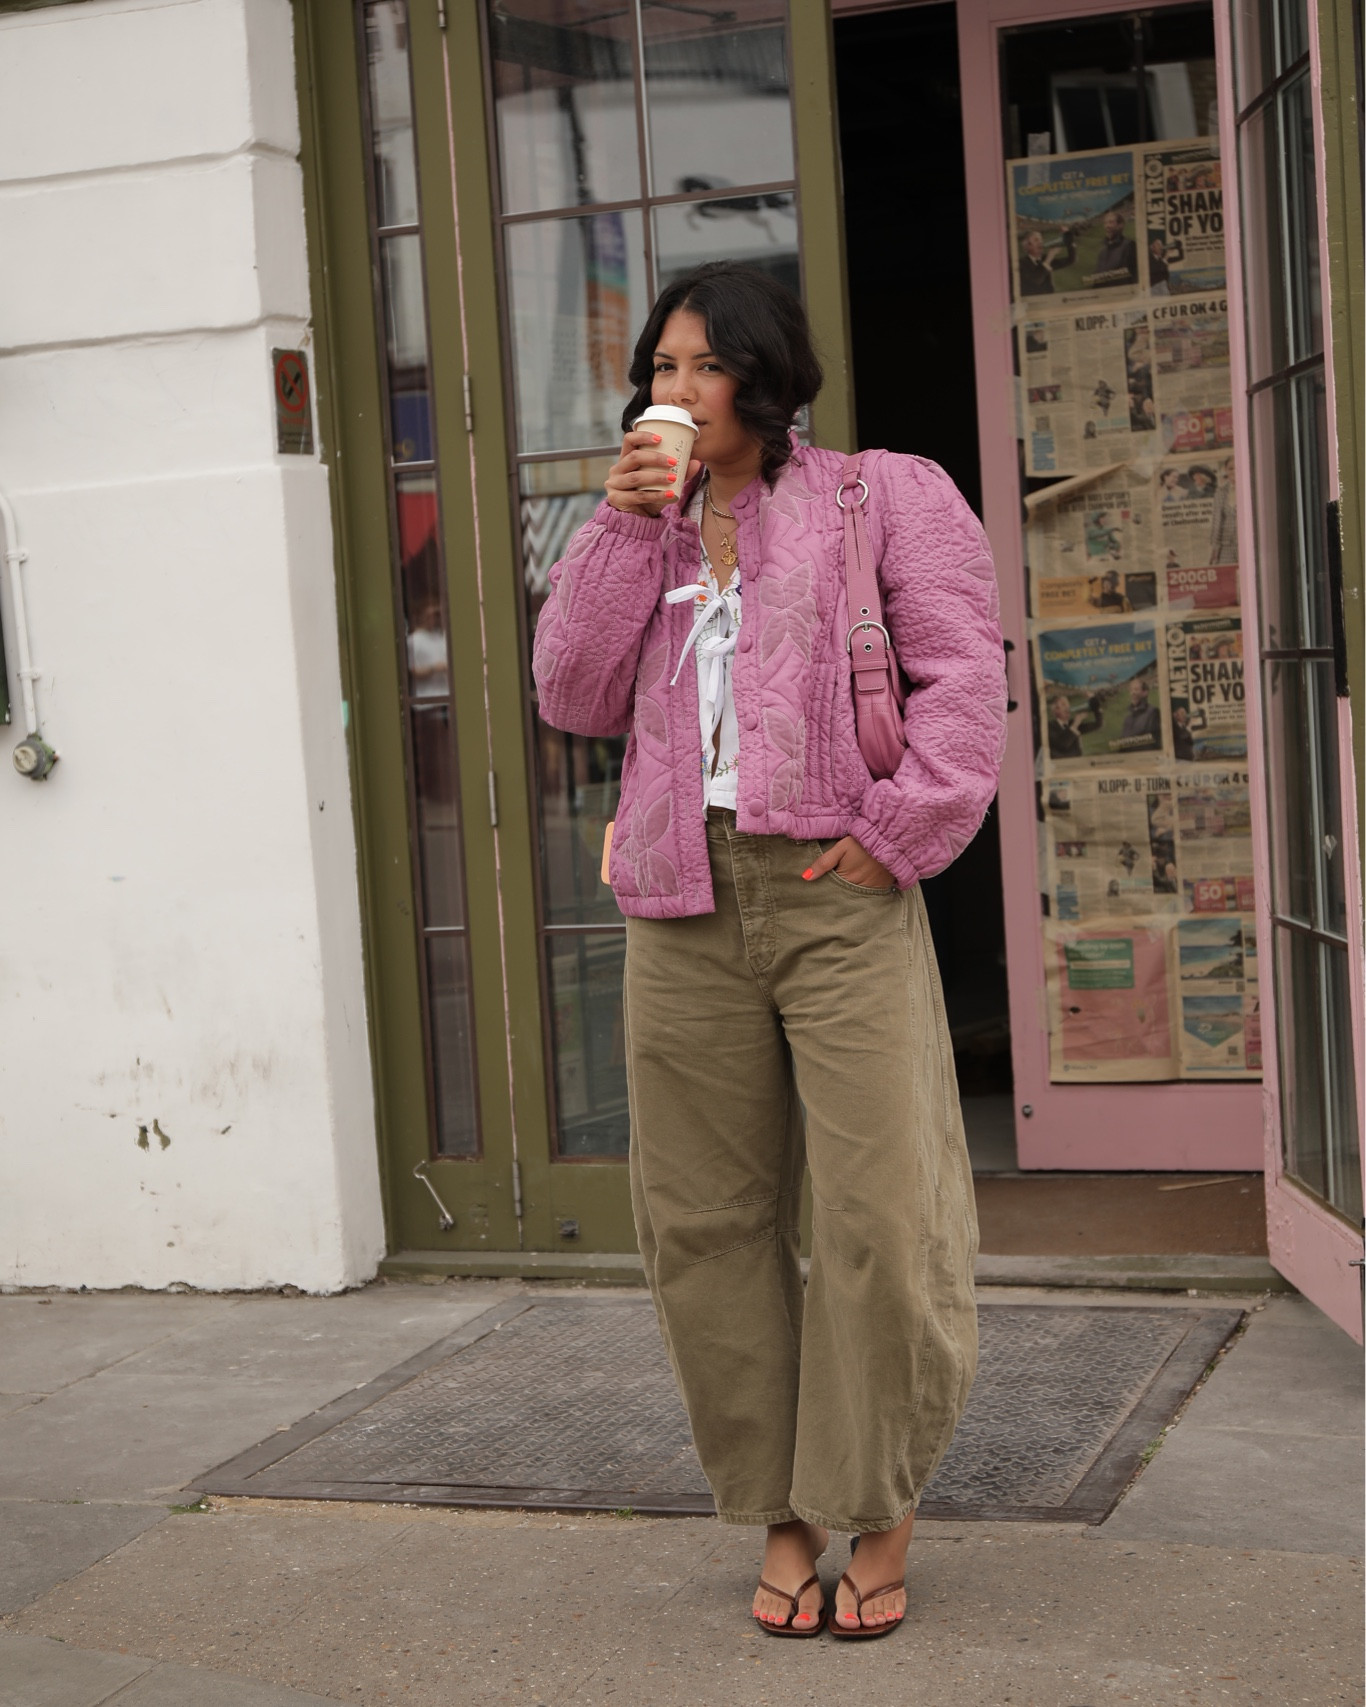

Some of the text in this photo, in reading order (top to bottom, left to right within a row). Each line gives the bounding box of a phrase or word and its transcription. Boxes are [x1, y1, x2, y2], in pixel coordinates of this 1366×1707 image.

[1146, 159, 1166, 230] METRO
[1168, 190, 1222, 216] SHAM
[1169, 212, 1224, 236] OF YO
[1176, 417, 1201, 436] 50
[1169, 568, 1217, 585] 200GB
[1167, 627, 1188, 698] METRO
[1192, 681, 1246, 704] OF YO
[1098, 778, 1132, 793] KLOPP:
[1199, 884, 1222, 901] 50
